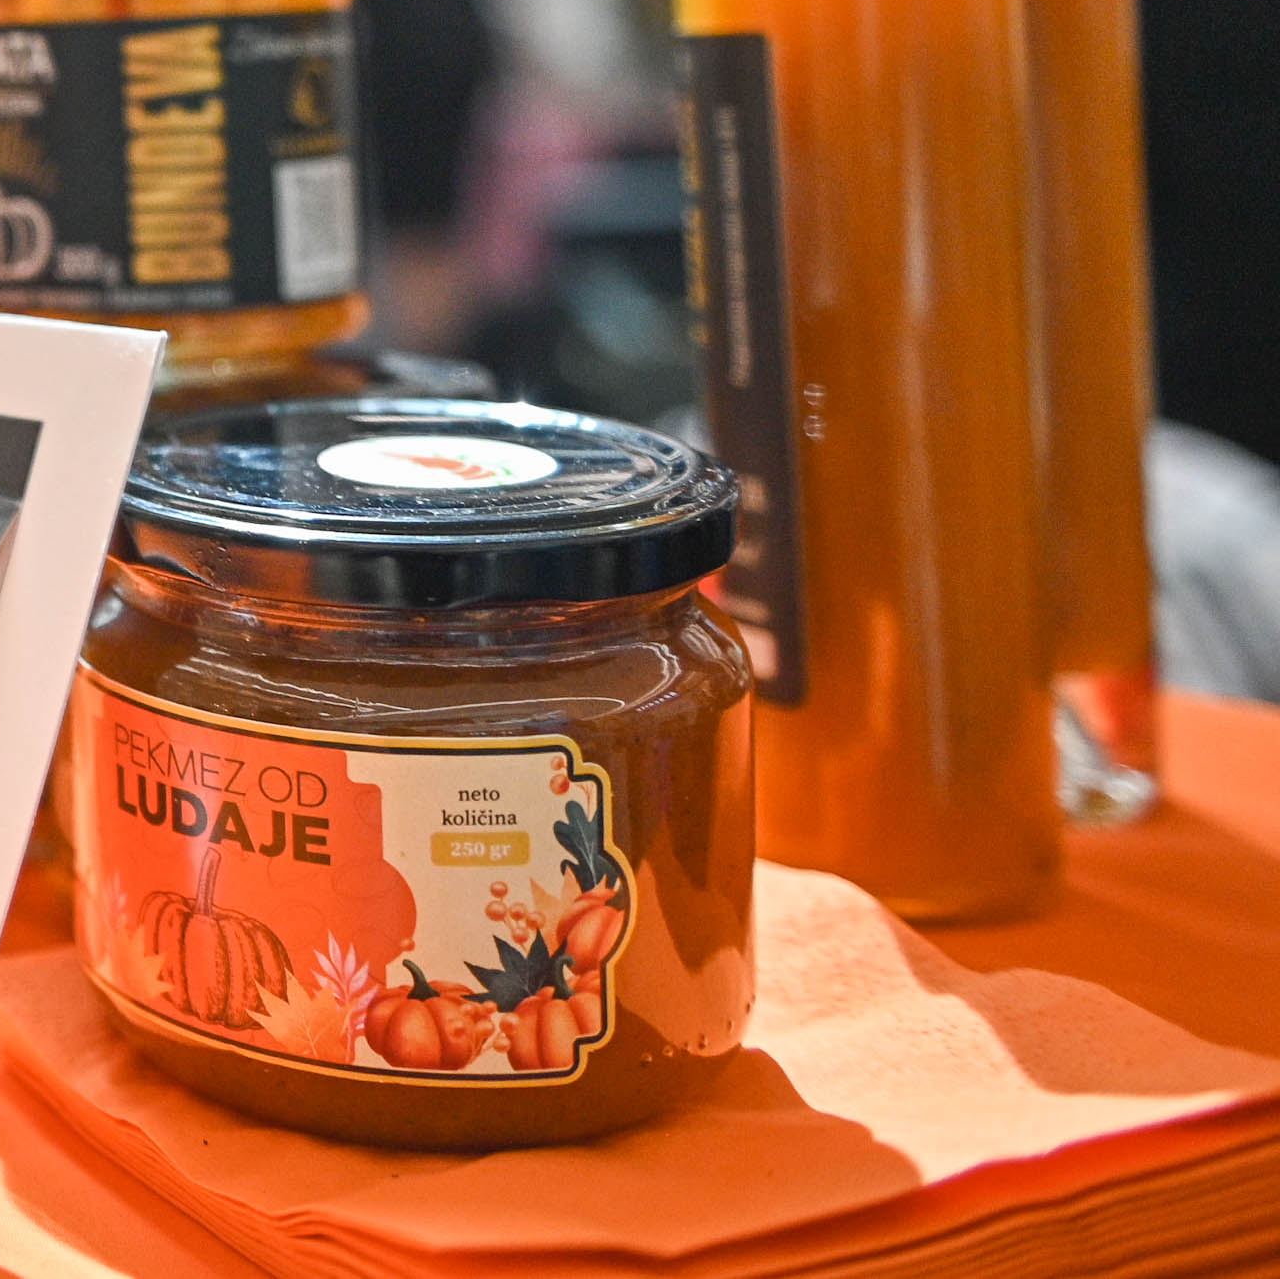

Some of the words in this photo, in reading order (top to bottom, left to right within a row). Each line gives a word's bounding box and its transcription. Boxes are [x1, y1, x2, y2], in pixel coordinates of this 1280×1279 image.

[119, 24, 232, 285] BUNDEVA
[113, 721, 247, 797] PEKMEZ
[257, 765, 328, 808] OD
[115, 763, 332, 866] LUDAJE
[440, 808, 518, 827] količina
[457, 787, 501, 802] neto
[449, 840, 487, 858] 250
[489, 842, 513, 862] gr
